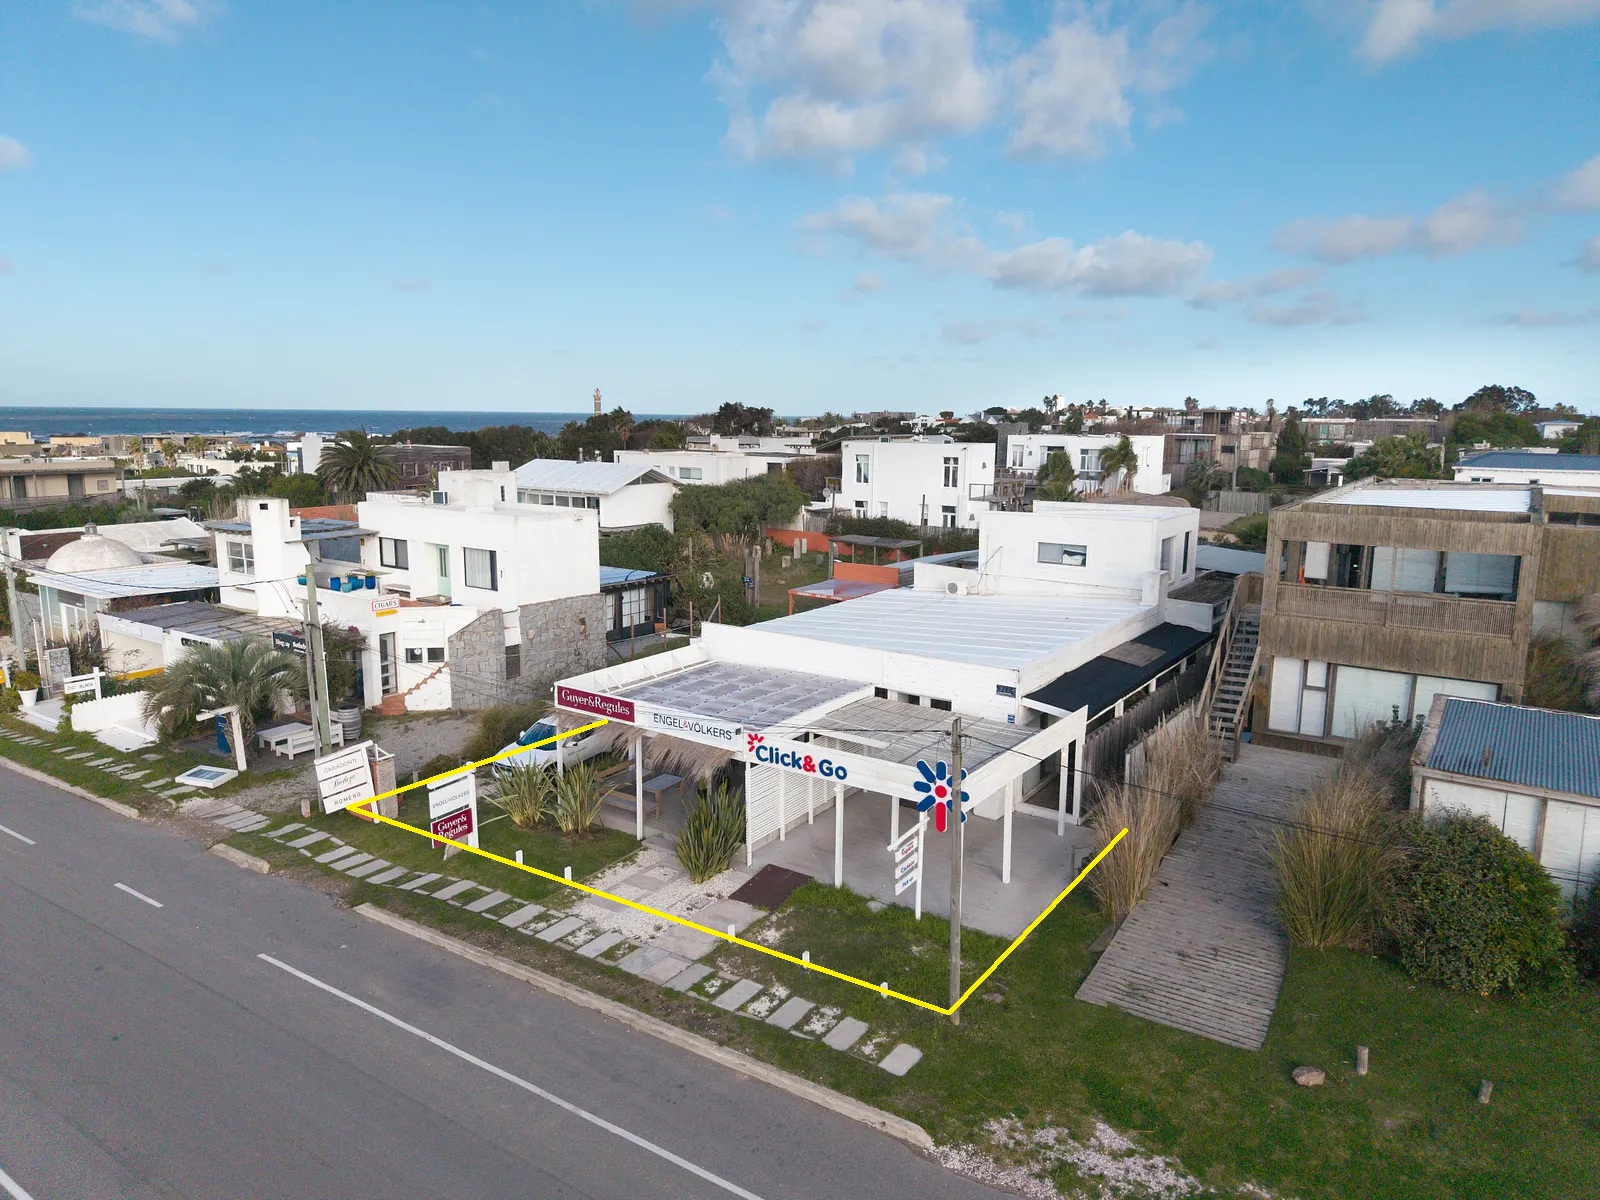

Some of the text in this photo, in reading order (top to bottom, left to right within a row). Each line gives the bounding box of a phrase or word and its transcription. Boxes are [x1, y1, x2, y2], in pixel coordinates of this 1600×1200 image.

[374, 600, 398, 610] CIGARS
[561, 689, 630, 715] Guyer&Regules
[653, 713, 732, 740] ENGEL&VÖLKERS
[334, 792, 361, 805] ROMERO
[437, 813, 467, 832] Guyer&
